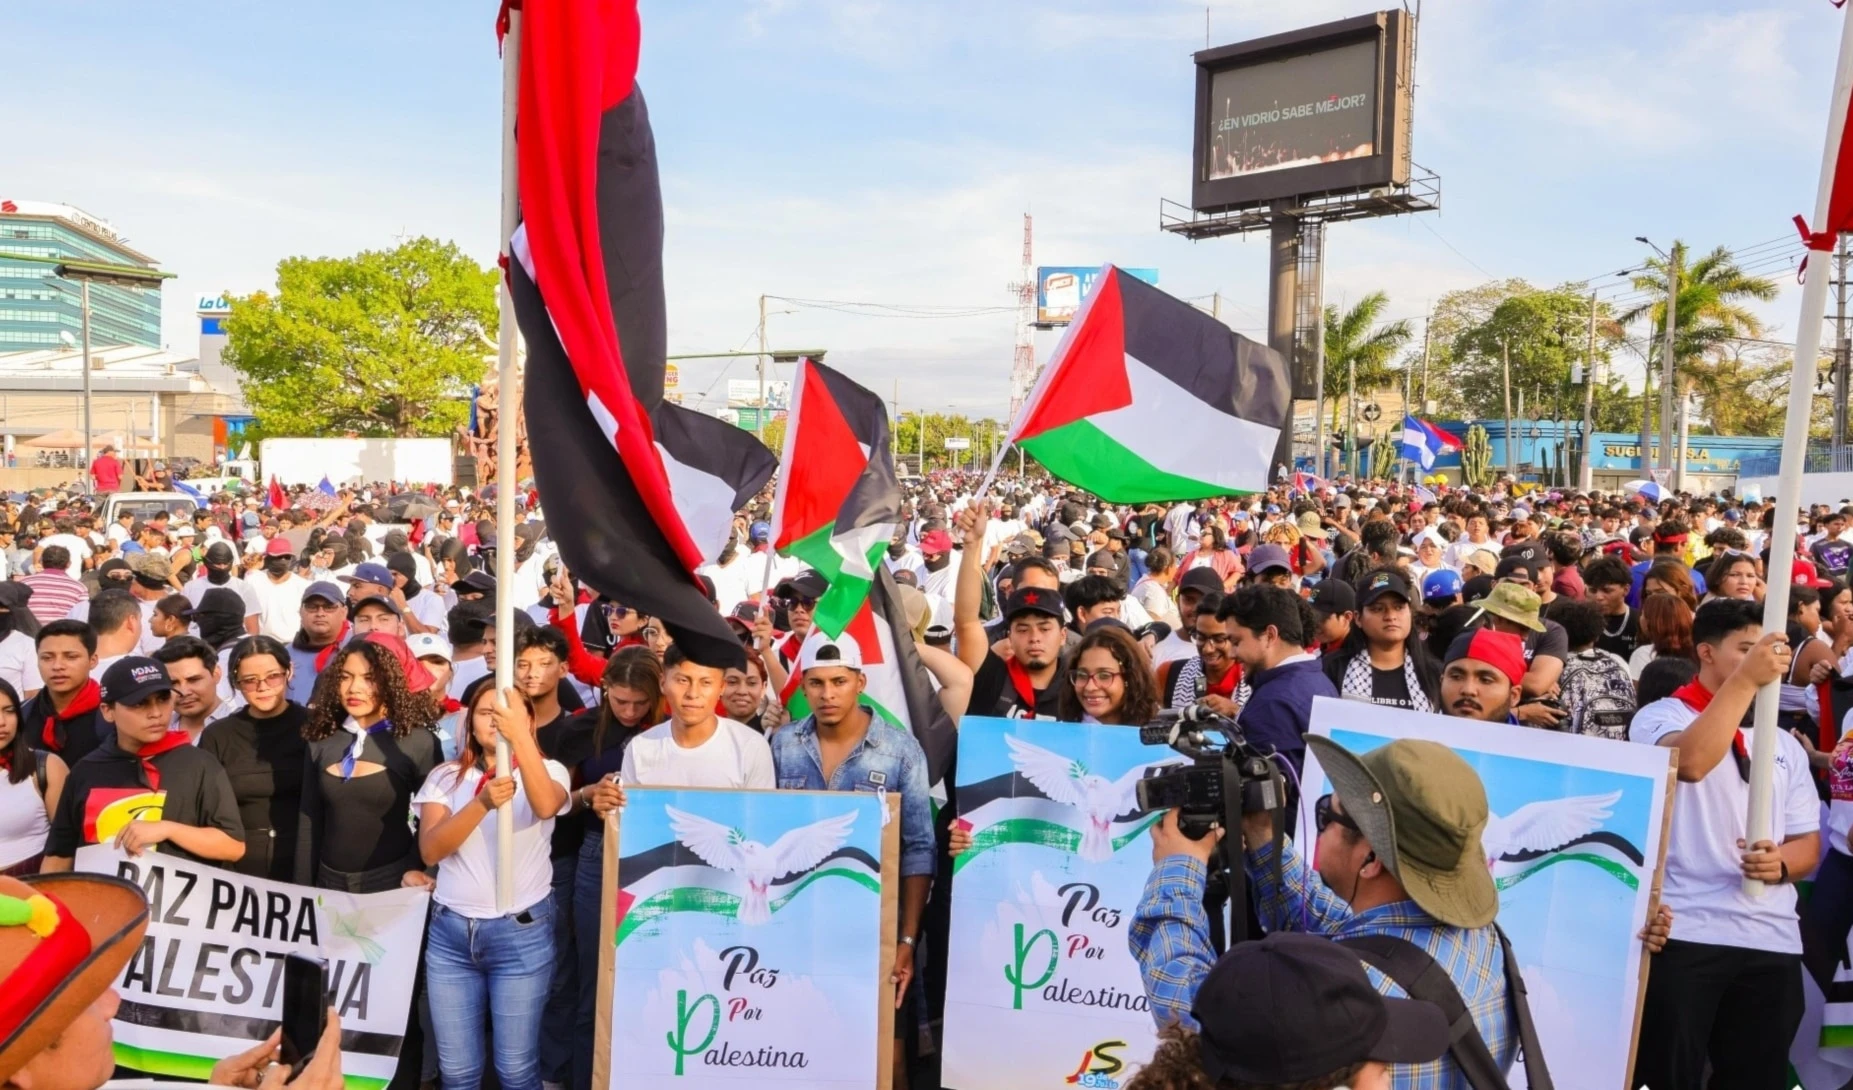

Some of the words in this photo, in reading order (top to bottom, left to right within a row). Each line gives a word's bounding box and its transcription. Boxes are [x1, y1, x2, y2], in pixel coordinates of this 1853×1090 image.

[1218, 117, 1240, 132] ¿EN
[1241, 109, 1280, 128] VIDRIO
[1281, 103, 1314, 121] SABE
[1315, 93, 1366, 115] MEJOR?
[199, 296, 214, 309] La
[205, 878, 320, 947] PARA
[1057, 882, 1122, 929] Paz
[719, 945, 780, 991] Paz
[1004, 923, 1151, 1012] Palestina
[1066, 934, 1105, 960] Por
[666, 989, 809, 1076] Palestina
[728, 997, 763, 1022] Por
